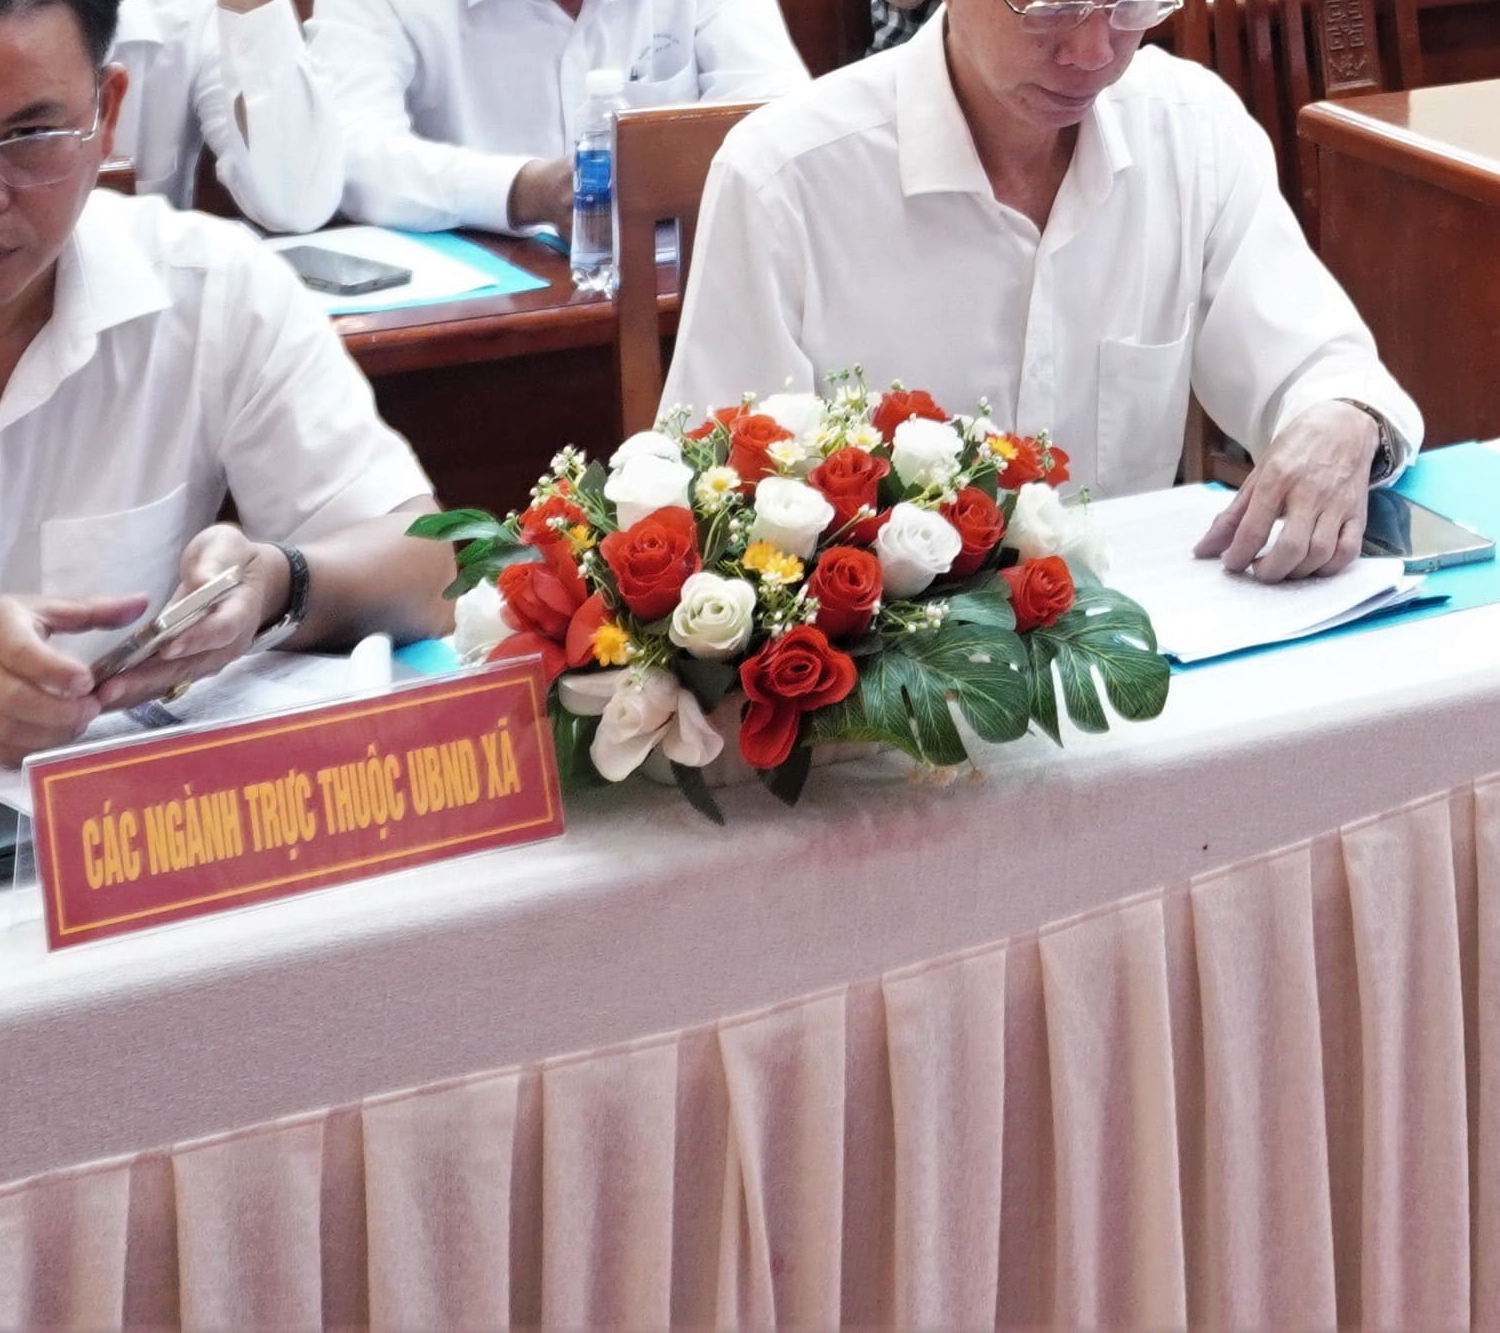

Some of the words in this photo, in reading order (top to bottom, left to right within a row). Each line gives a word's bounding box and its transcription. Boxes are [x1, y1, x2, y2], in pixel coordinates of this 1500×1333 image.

[82, 799, 141, 891] CÁC
[144, 784, 243, 875] NGÀNH
[245, 768, 316, 861] TRỰC
[319, 744, 405, 840] THUỘC
[406, 734, 480, 816] UBND
[480, 717, 522, 801] XÃ
